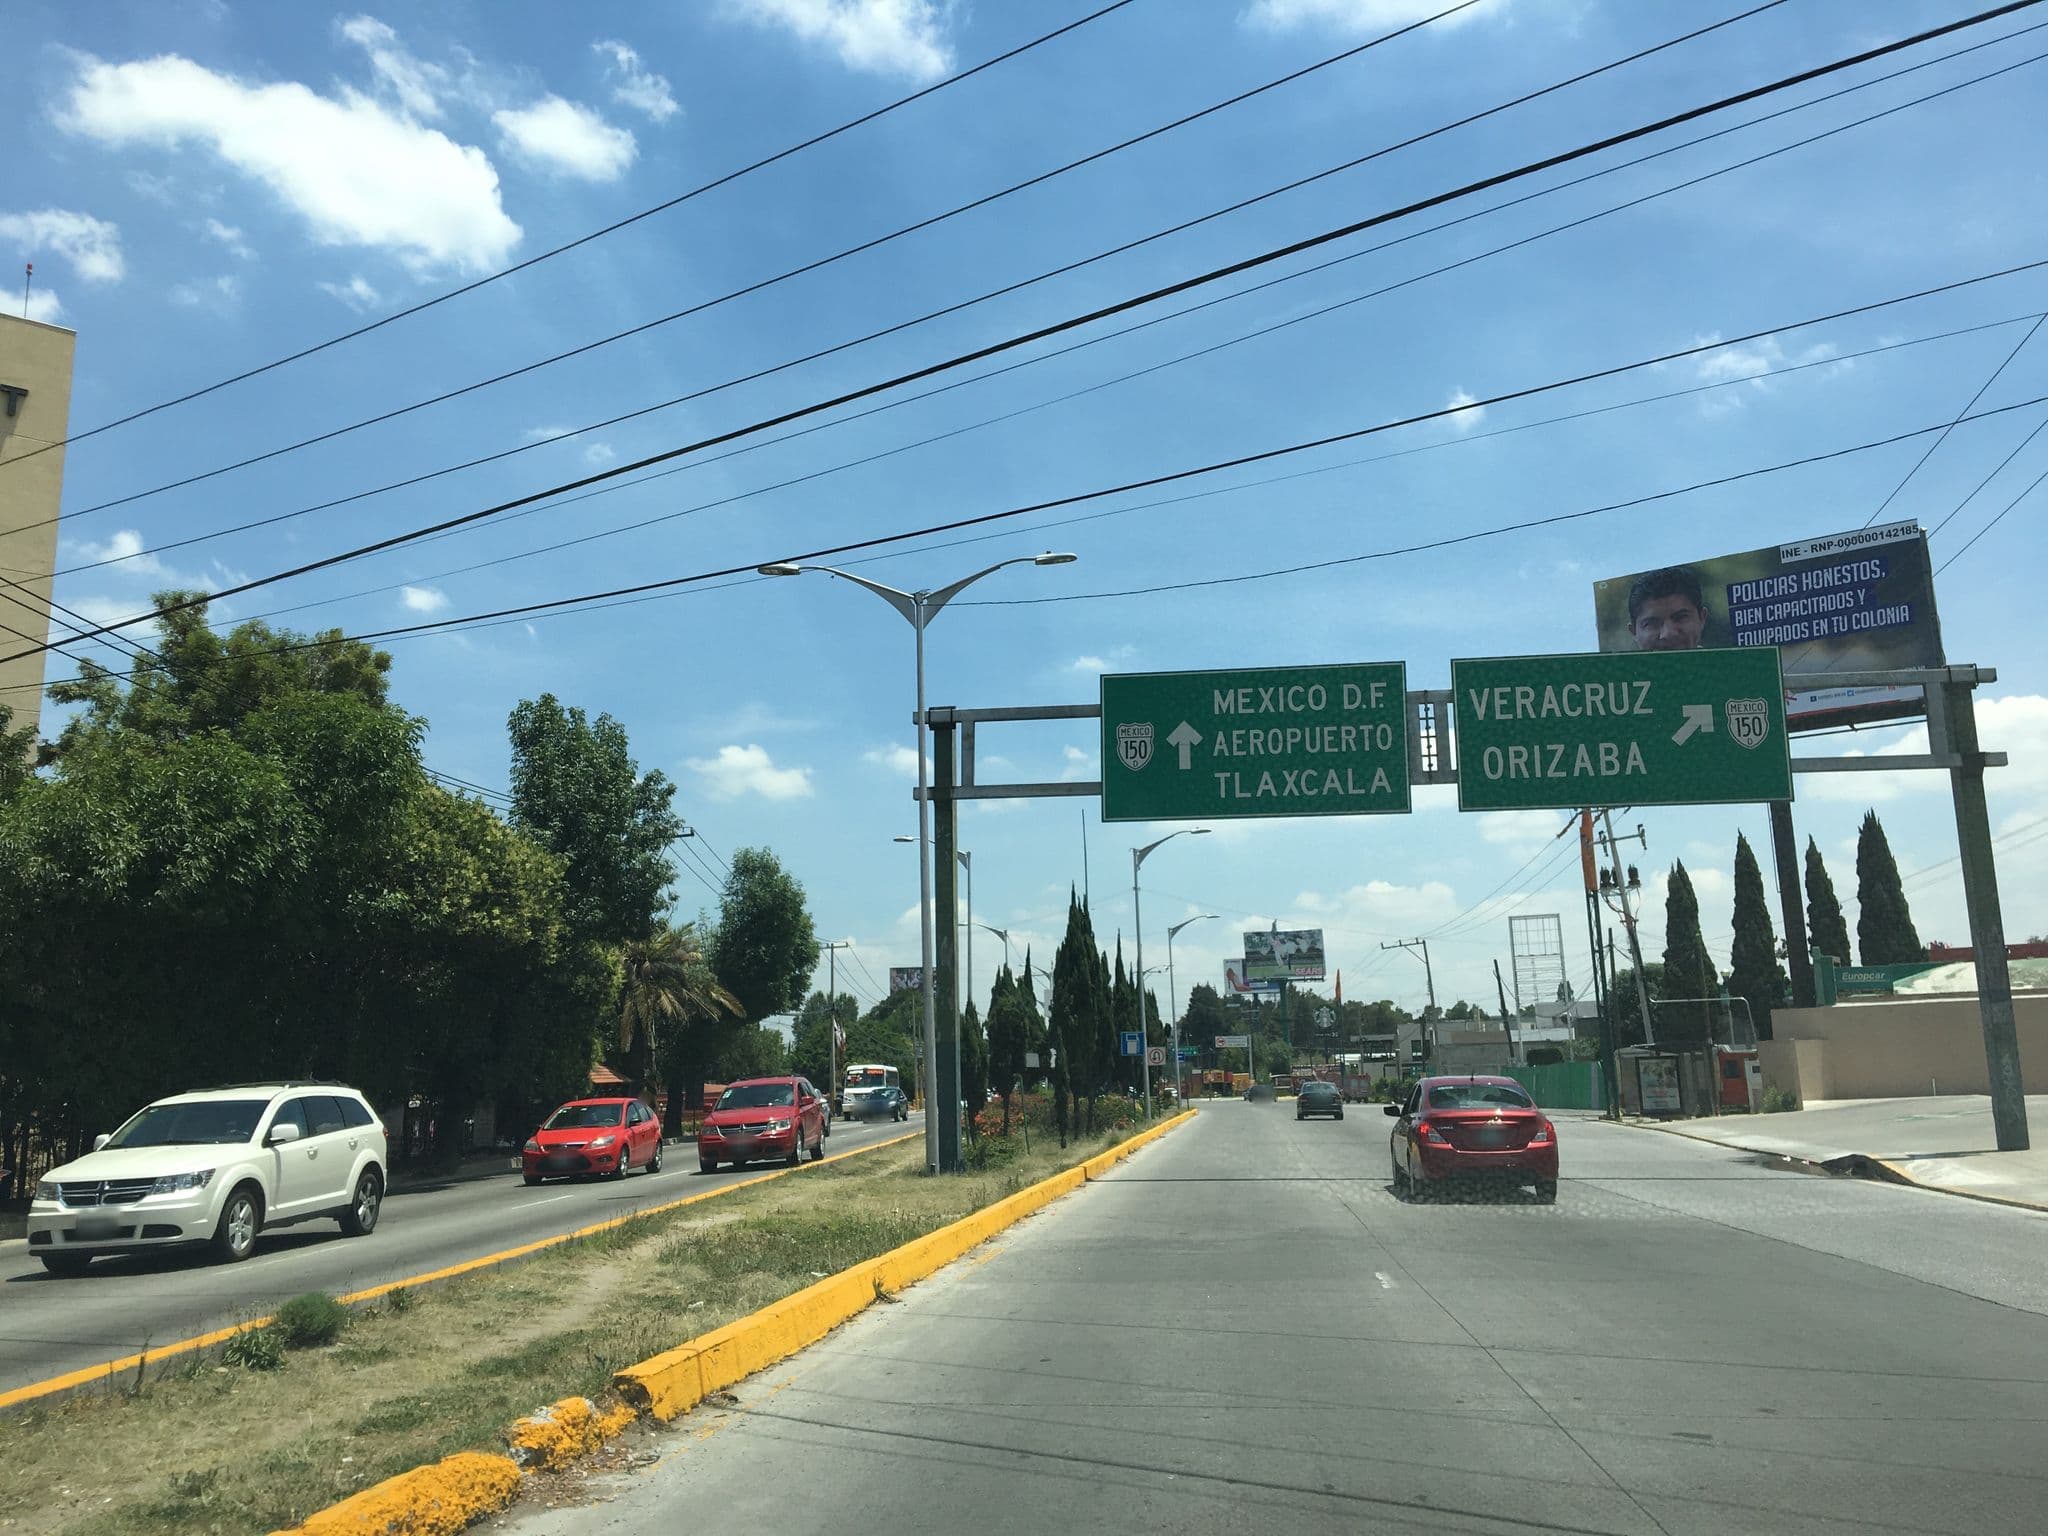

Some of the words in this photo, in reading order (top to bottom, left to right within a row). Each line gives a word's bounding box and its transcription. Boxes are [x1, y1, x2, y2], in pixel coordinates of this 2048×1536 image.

[1781, 548, 1801, 559] INE
[1733, 574, 1798, 603] POLICIAS
[1802, 559, 1886, 591] HONESTOS,
[1735, 607, 1763, 627] BIEN
[1766, 590, 1854, 621] CAPACITADOS
[1857, 588, 1866, 605] Y
[1812, 619, 1829, 637] EN
[1831, 615, 1848, 634] TU
[1852, 605, 1910, 630] COLONIA
[1213, 684, 1327, 715] MEXICO
[1469, 680, 1653, 721] VERACRUZ
[1730, 703, 1764, 713] MEXICO
[1120, 727, 1150, 736] MEXICO
[1212, 723, 1393, 757] AEROPUERTO
[1735, 716, 1763, 738] 150
[1124, 740, 1148, 760] 150
[1483, 741, 1648, 780] ORIZABA
[1214, 767, 1392, 799] TLAXCALA
[1295, 967, 1323, 976] SEARS
[1841, 971, 1886, 982] Europcar
